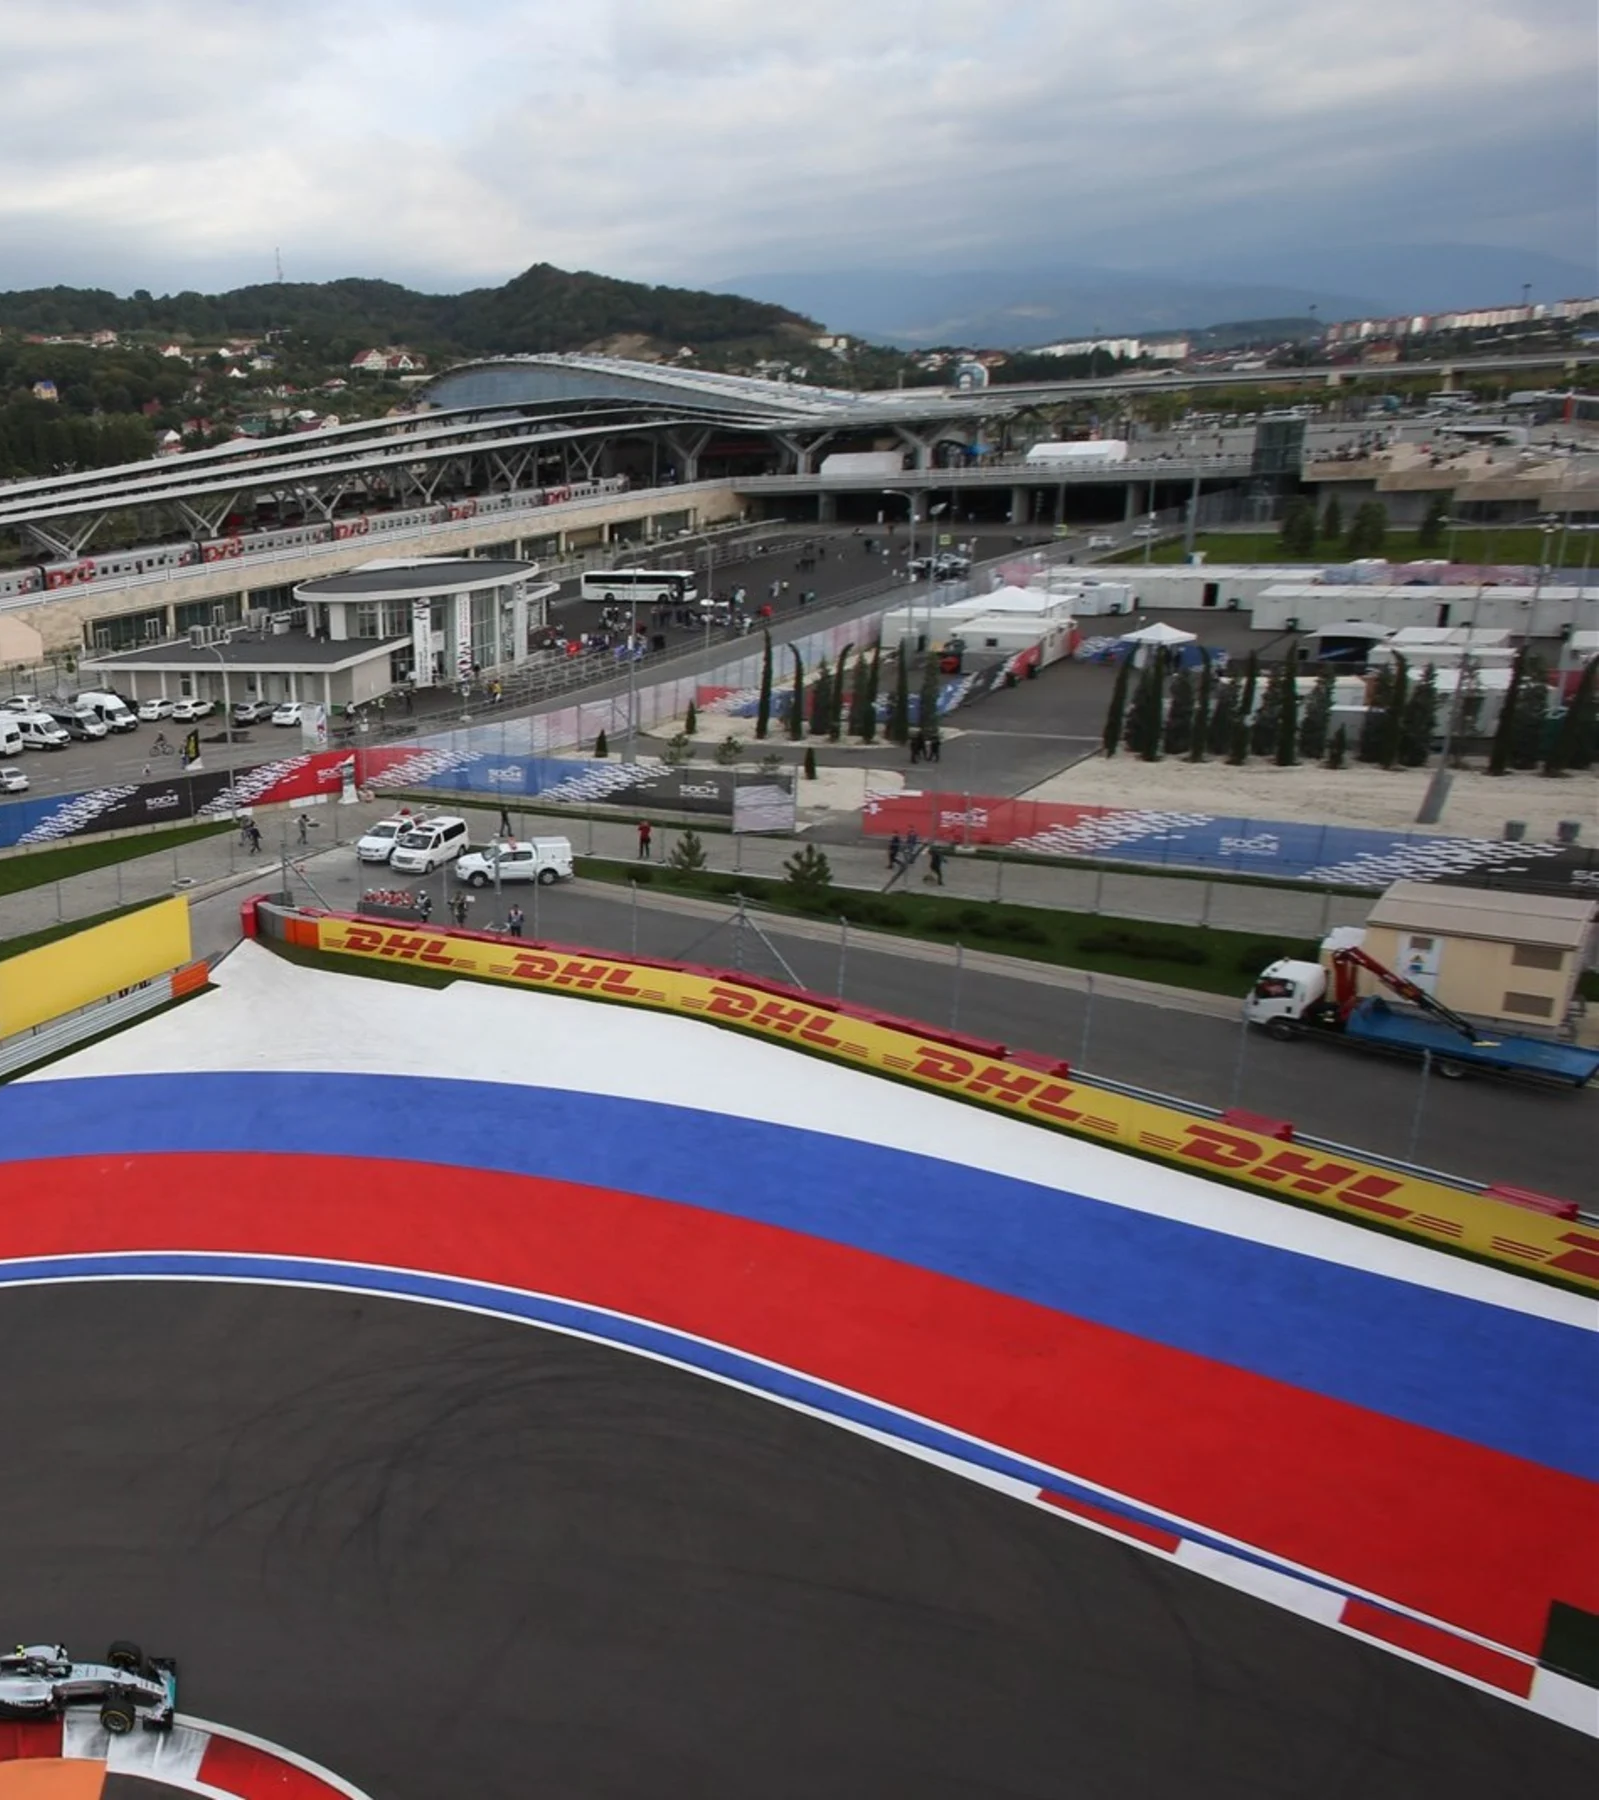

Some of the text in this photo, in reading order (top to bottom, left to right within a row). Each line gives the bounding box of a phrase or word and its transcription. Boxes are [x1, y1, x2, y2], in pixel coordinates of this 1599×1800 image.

[344, 927, 453, 965] DHL
[512, 953, 640, 996] DHL
[705, 986, 841, 1048] DHL
[911, 1046, 1084, 1121] DHL
[1177, 1124, 1413, 1220] DHL
